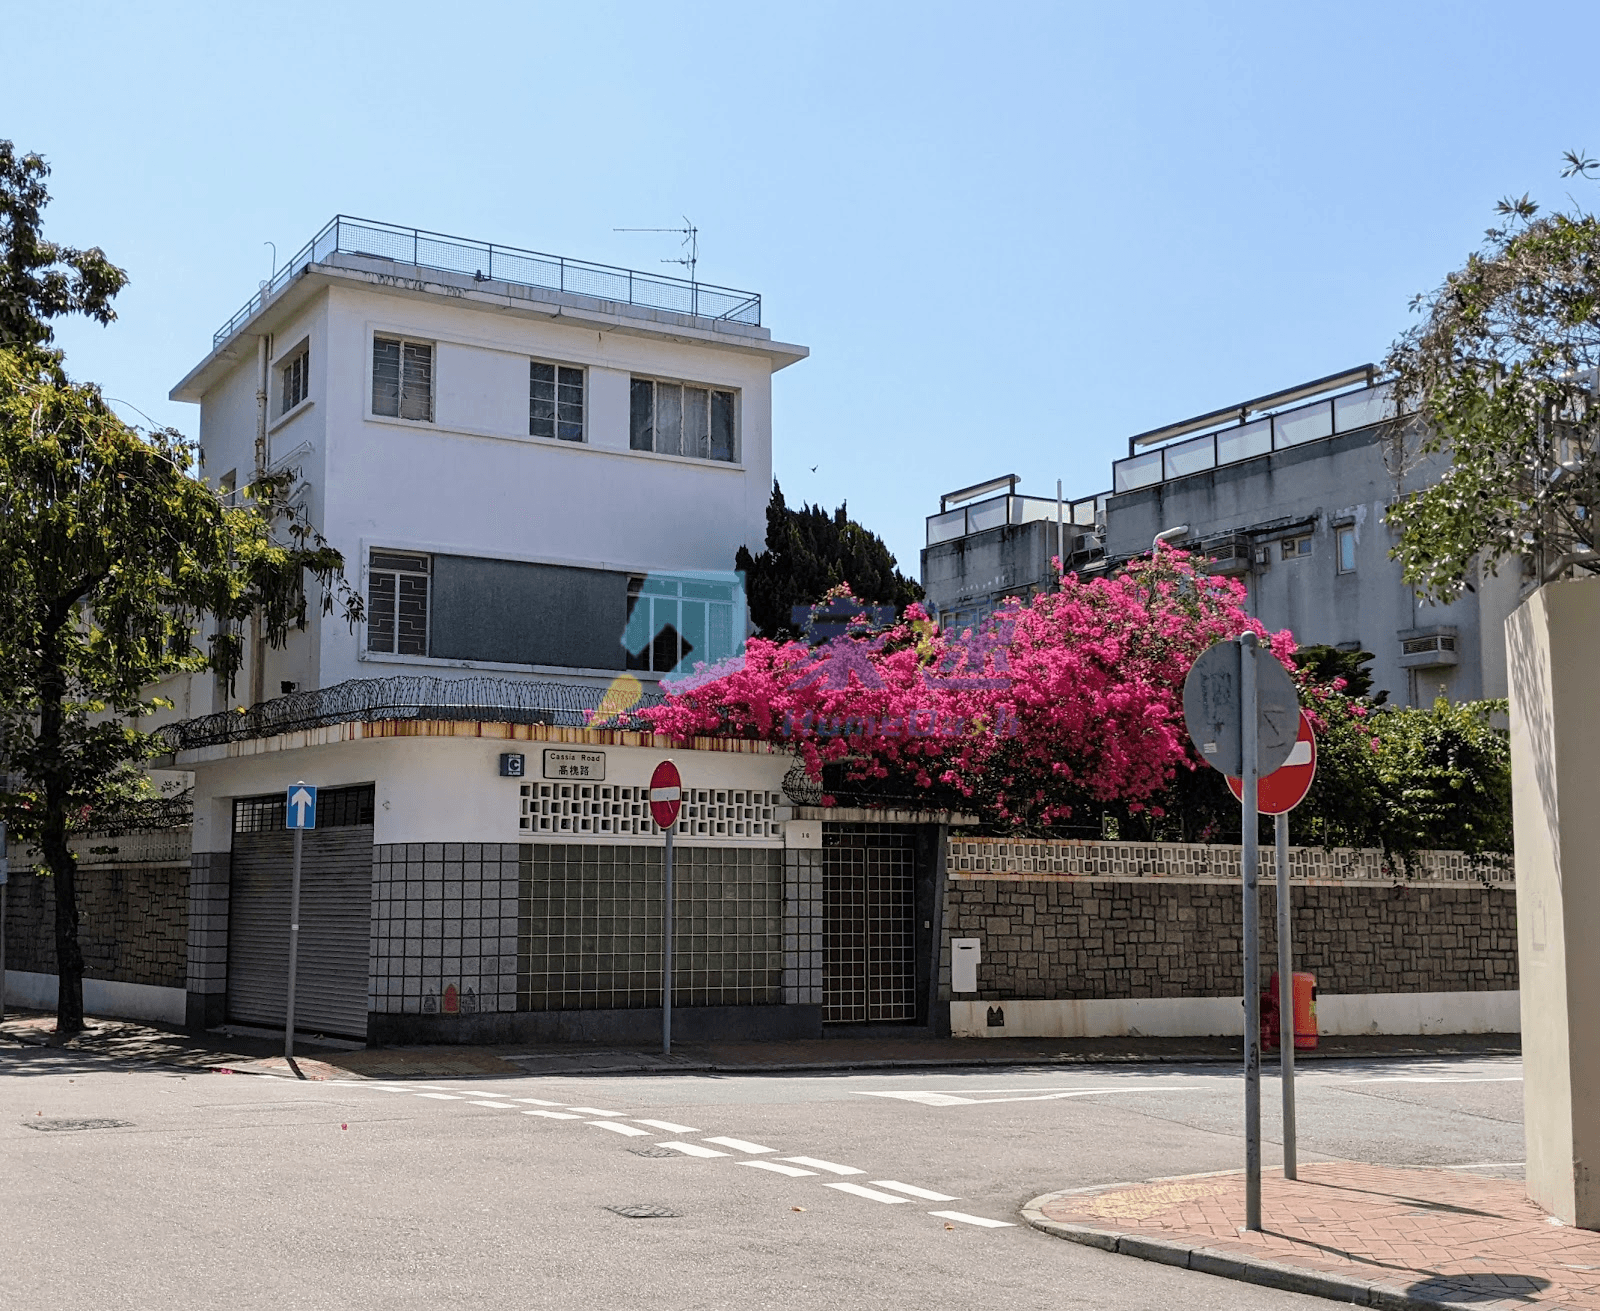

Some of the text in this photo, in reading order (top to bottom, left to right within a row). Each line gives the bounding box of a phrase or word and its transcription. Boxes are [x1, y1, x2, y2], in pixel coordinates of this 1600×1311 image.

[550, 753, 601, 762] Cassia Road
[559, 765, 590, 776] 高槐路
